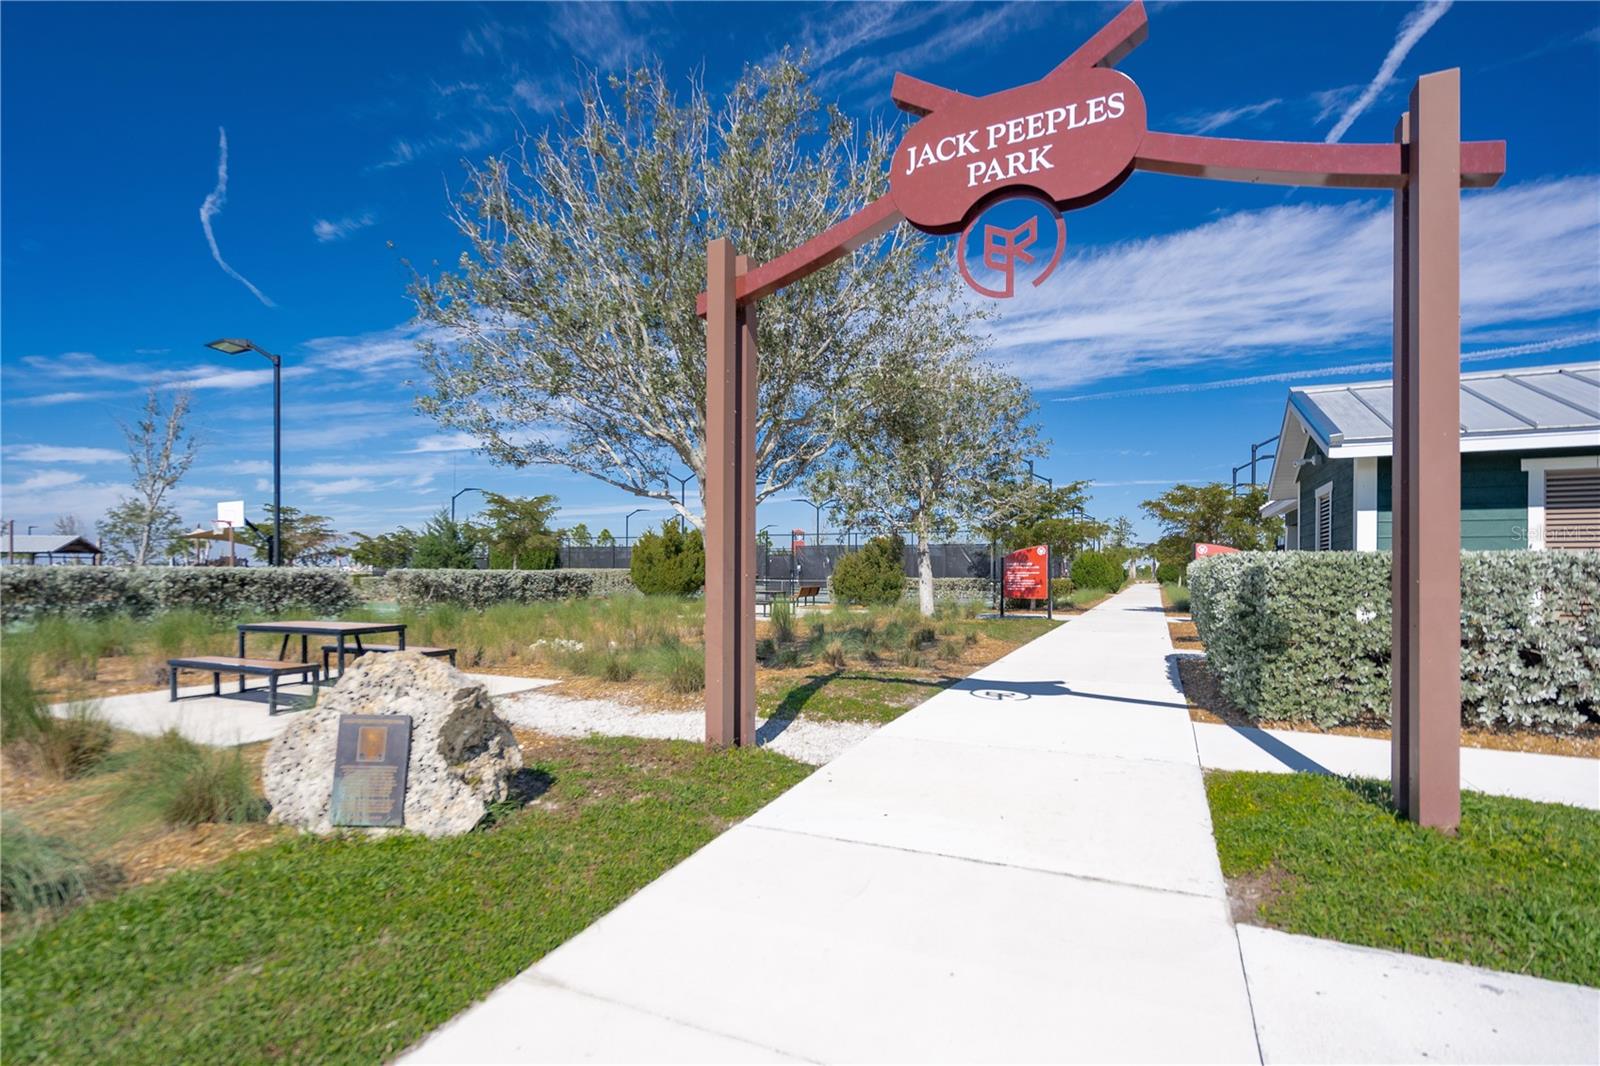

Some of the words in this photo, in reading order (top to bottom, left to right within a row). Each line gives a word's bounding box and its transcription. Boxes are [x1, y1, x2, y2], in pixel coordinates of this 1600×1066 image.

[906, 130, 979, 175] JACK
[986, 92, 1125, 149] PEEPLES
[967, 144, 1054, 187] PARK
